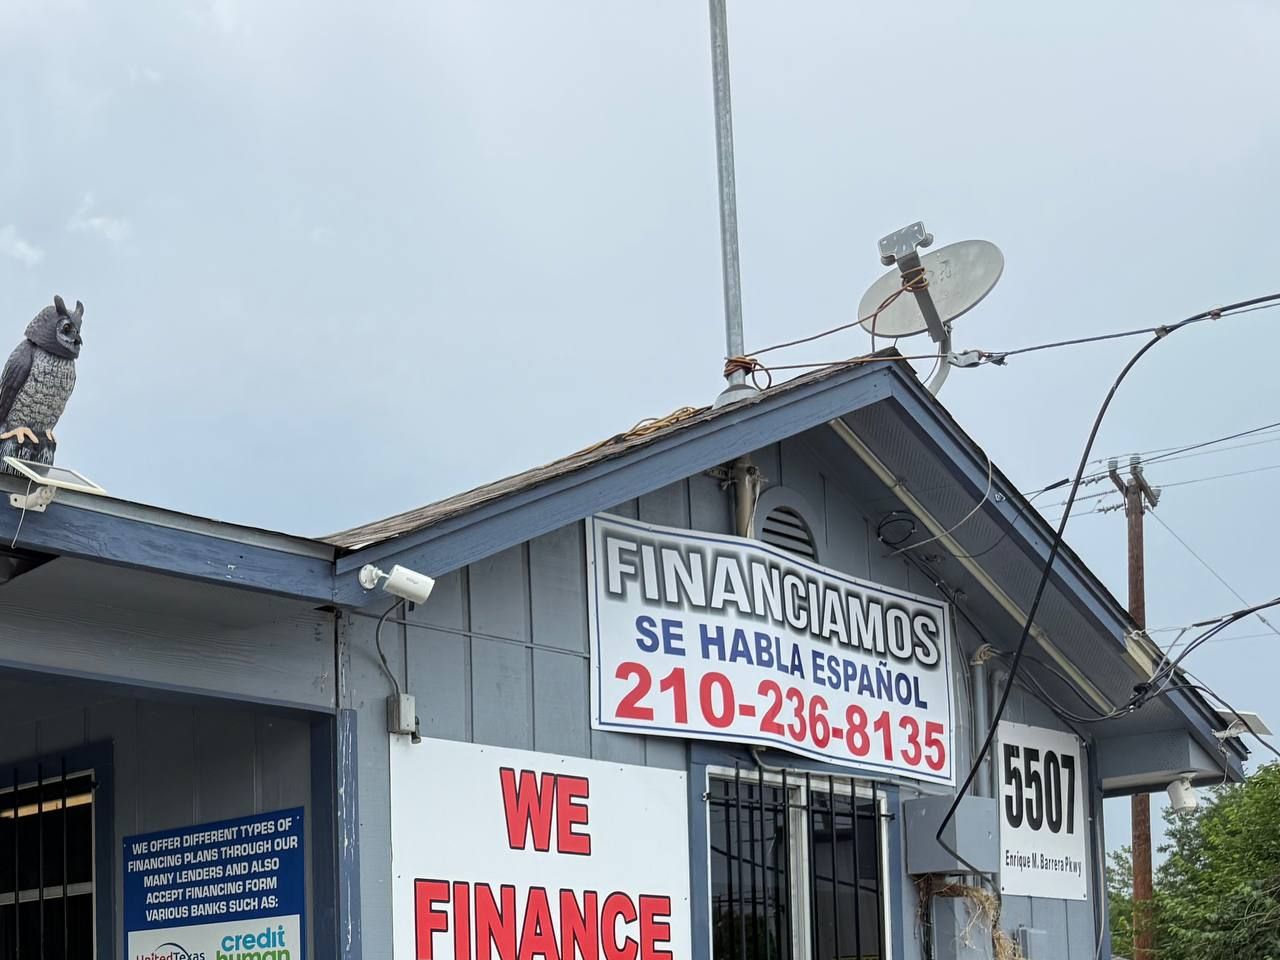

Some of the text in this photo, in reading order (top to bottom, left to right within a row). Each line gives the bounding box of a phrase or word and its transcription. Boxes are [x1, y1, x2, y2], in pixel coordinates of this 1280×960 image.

[604, 535, 942, 669] FINANCIAMOS
[635, 615, 928, 710] SE HABLA ESPAÑOL
[614, 661, 946, 772] 210-236-8135
[1002, 743, 1075, 835] 5507
[498, 766, 592, 857] WE
[128, 835, 298, 873] FINANCING PLANS THROUGH OUR
[132, 817, 292, 855] WE OFFER DIFFERENT TYPES OF
[143, 857, 280, 888] MANY LENDERS AND ALSO
[1005, 849, 1082, 878] Enrique M. Barrera Pkwy
[146, 876, 278, 905] ACCEPT FINANCING FORM
[146, 895, 279, 921] VARIOUS BANKS SUCH AS:
[221, 924, 286, 952] credit
